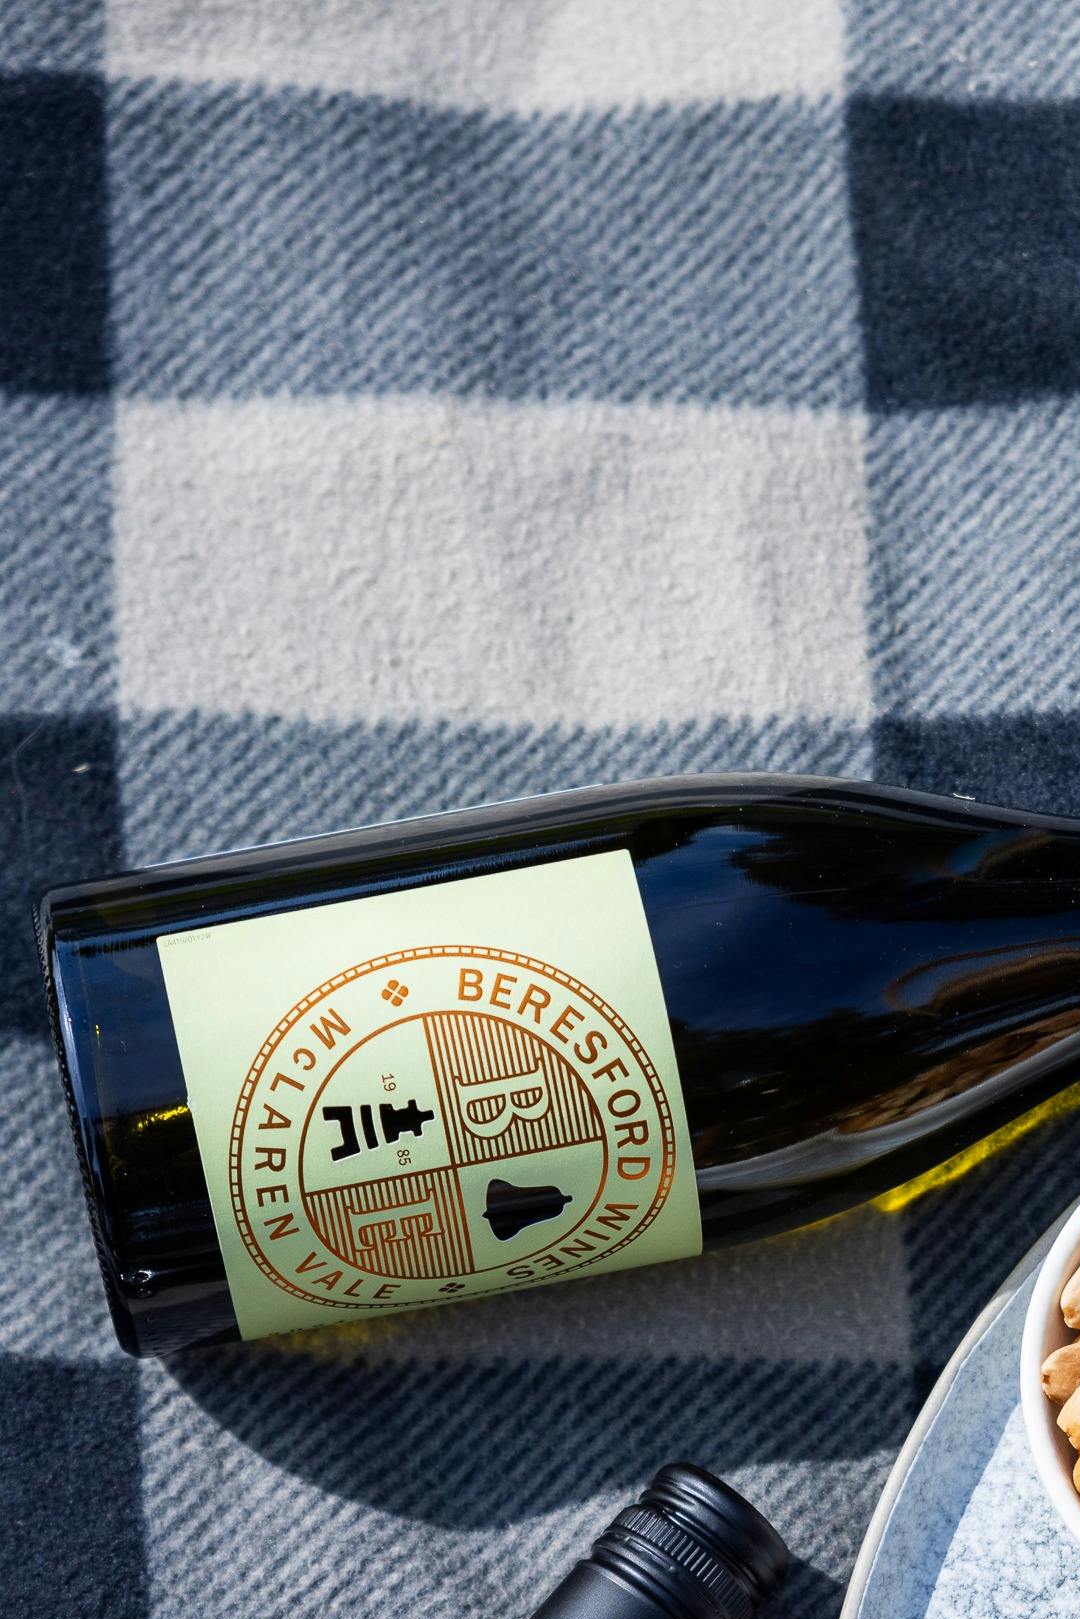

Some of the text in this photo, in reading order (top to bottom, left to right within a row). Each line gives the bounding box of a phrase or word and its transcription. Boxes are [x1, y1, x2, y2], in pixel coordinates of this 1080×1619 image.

[381, 1072, 397, 1093] 19
[457, 967, 652, 1280] BERESFORD WINES
[396, 1148, 412, 1167] 85
[294, 1251, 402, 1300] VALE
